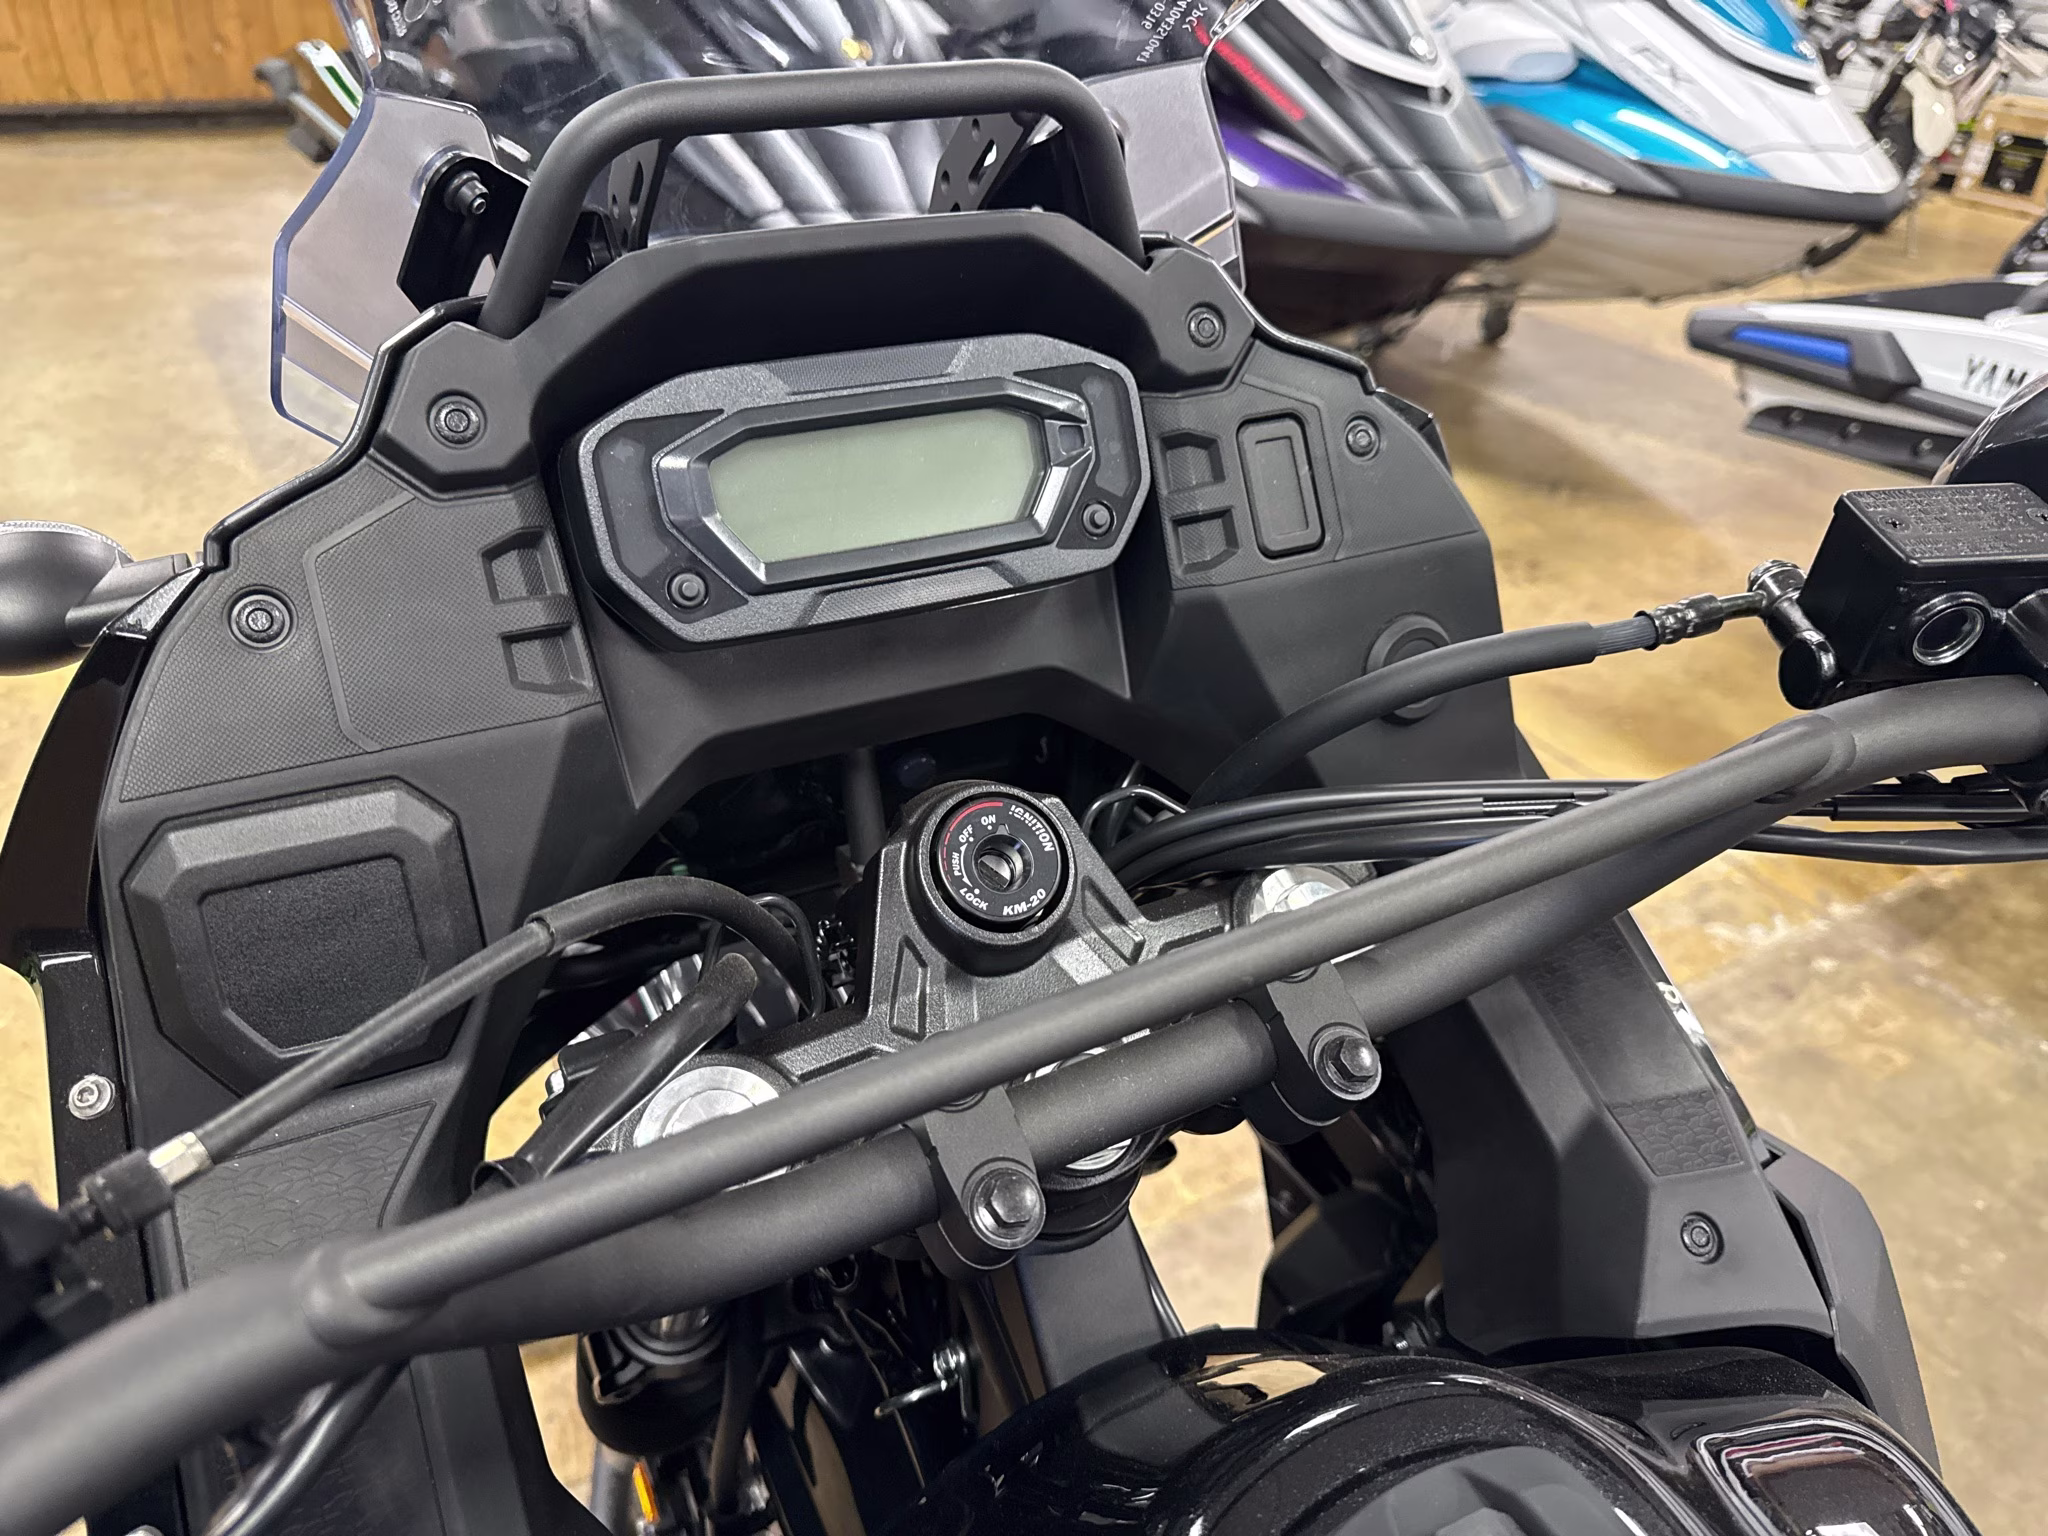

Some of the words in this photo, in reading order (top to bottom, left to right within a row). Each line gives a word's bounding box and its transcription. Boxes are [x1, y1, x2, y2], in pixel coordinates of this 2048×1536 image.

[981, 814, 996, 825] ON
[1009, 804, 1055, 852] IGNITION
[958, 824, 974, 843] OFF
[952, 851, 961, 877] PUSH
[959, 887, 989, 911] LOCK
[1002, 888, 1047, 916] KM-20
